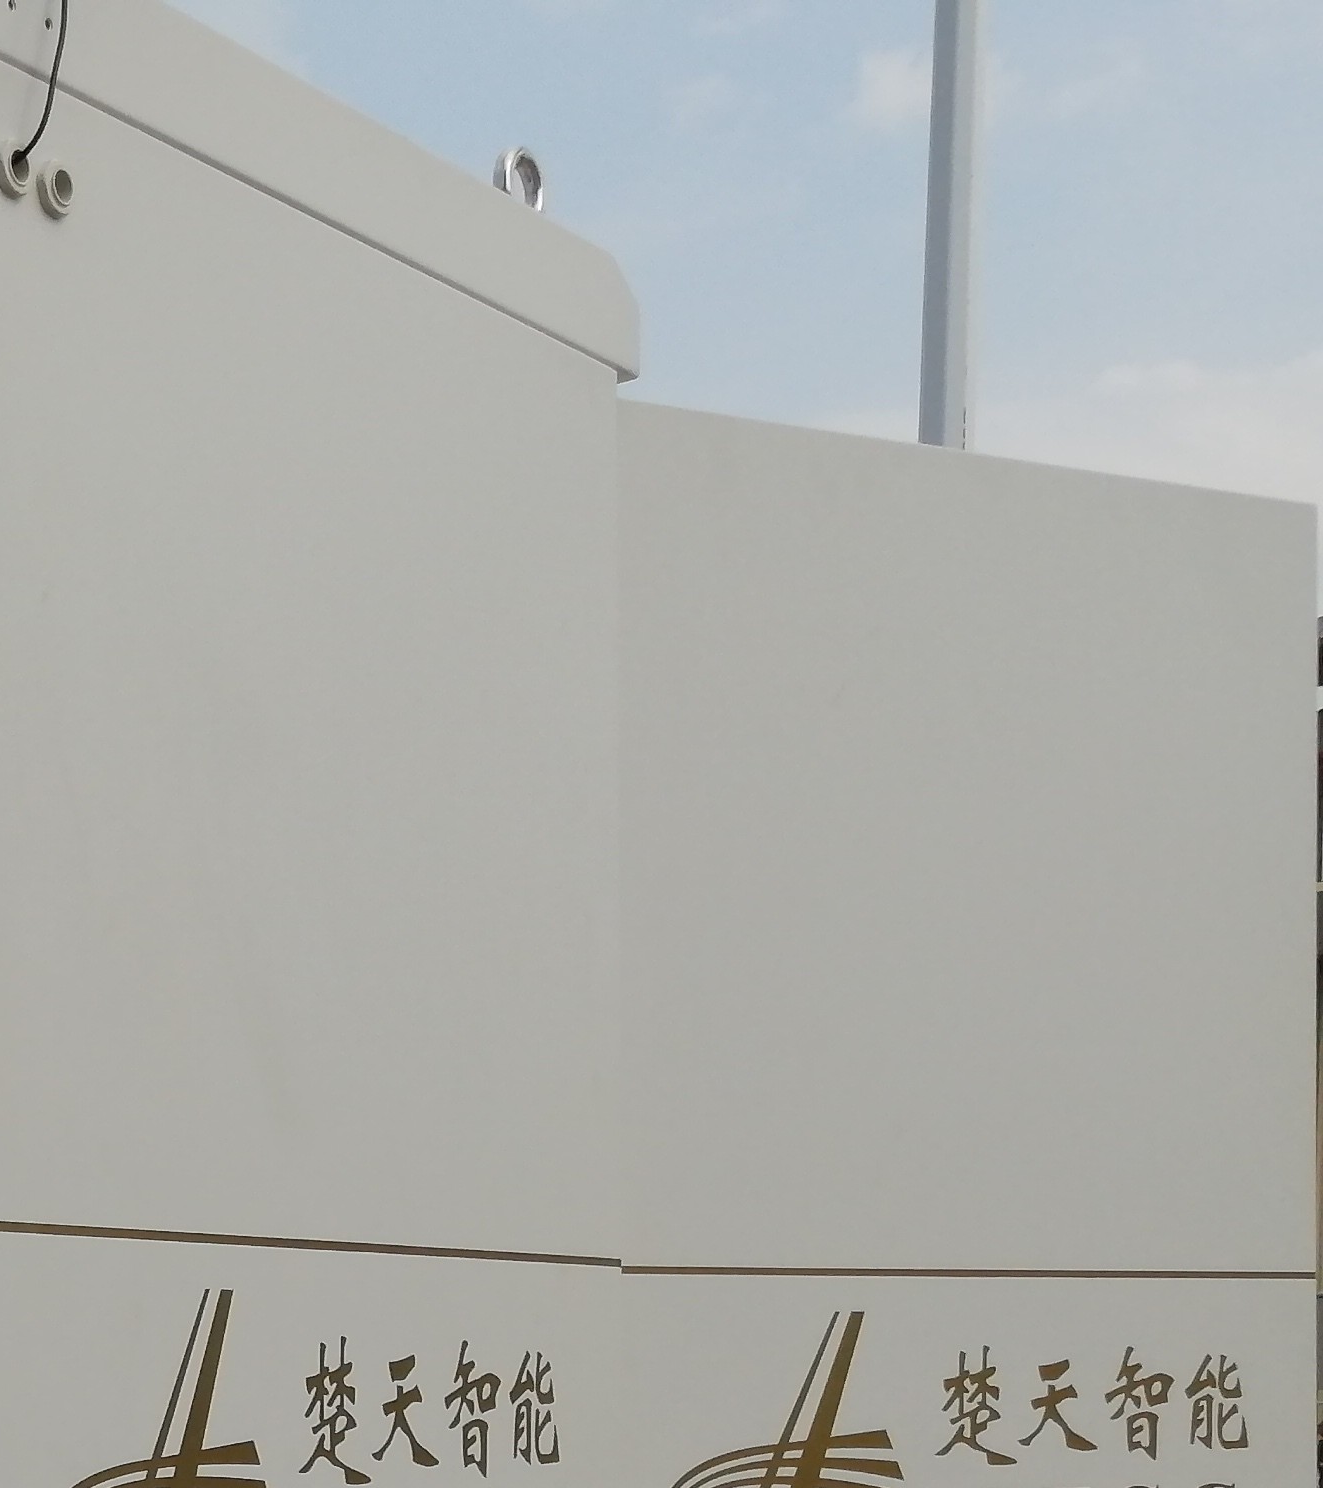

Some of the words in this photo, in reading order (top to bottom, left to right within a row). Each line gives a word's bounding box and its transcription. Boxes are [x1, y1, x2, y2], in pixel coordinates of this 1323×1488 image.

[298, 1335, 561, 1486] 楚天智能
[934, 1345, 1249, 1466] 楚天智能
